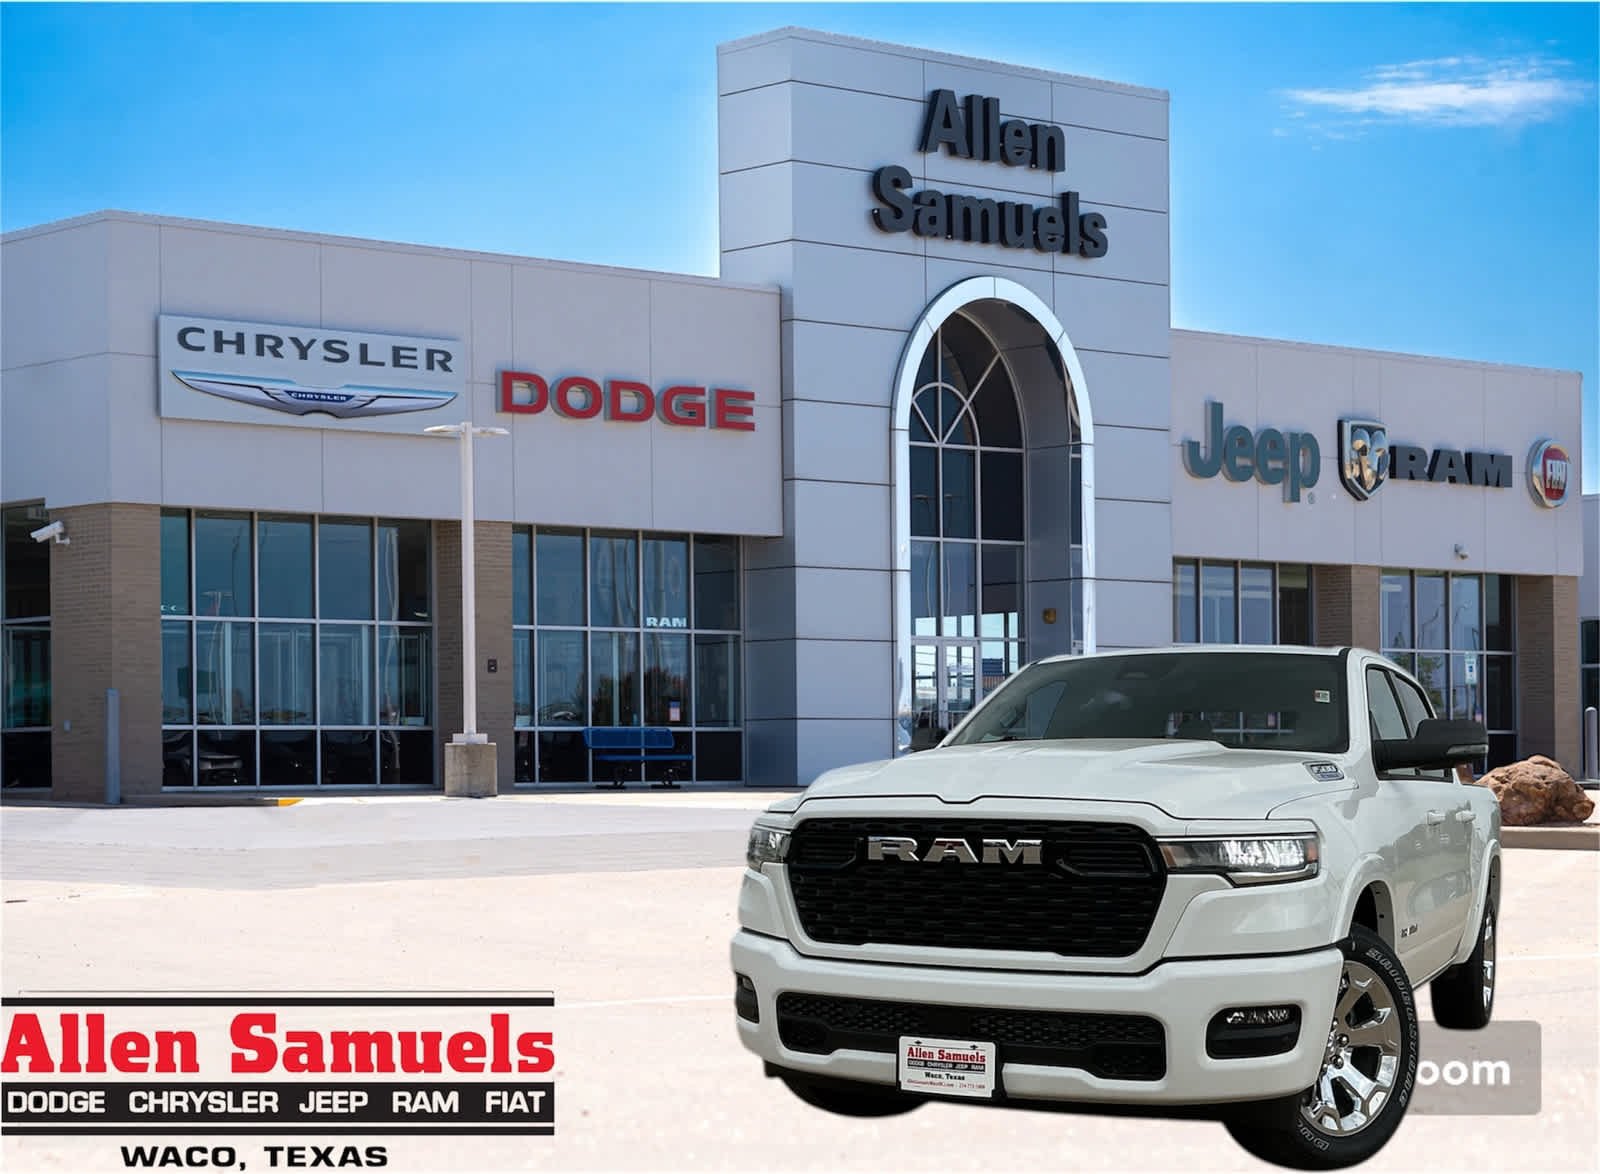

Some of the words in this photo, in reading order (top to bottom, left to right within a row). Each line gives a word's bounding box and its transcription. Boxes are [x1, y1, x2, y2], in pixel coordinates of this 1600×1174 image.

[918, 88, 1066, 172] Allen
[872, 165, 1108, 258] Samuels
[177, 326, 453, 372] CHRYSLER
[291, 391, 347, 401] CHRYSLER
[496, 370, 755, 431] DODGE
[1183, 400, 1320, 502] Jeep
[1389, 445, 1513, 487] RAM
[646, 617, 687, 628] RAM
[867, 836, 1042, 864] RAM
[907, 1047, 934, 1059] Allen
[938, 1049, 986, 1062] Samuels
